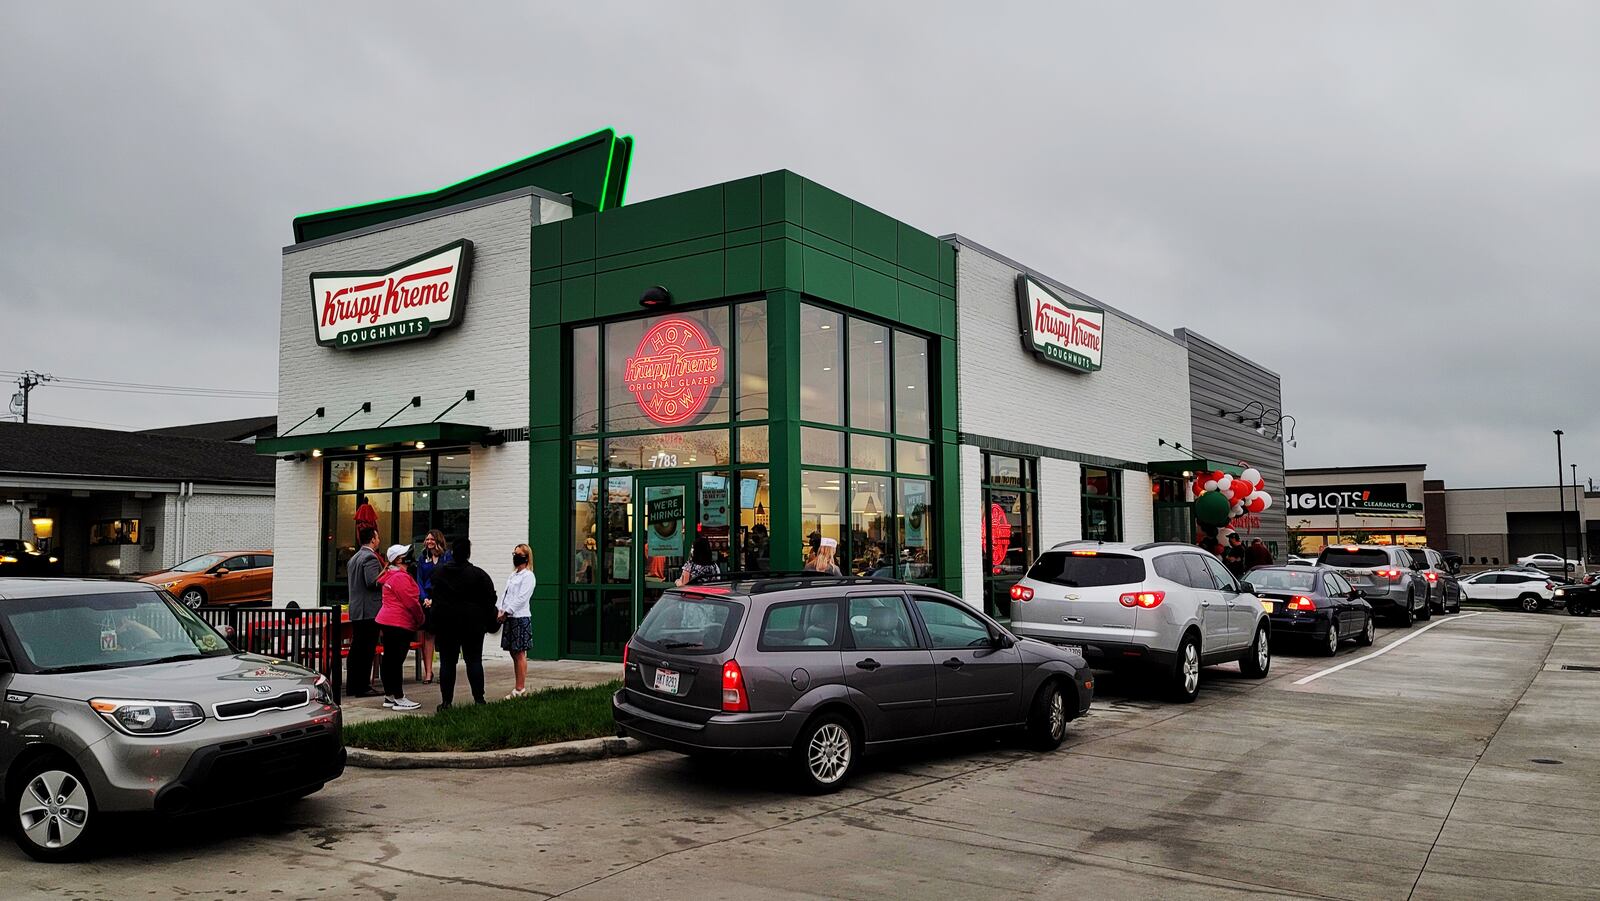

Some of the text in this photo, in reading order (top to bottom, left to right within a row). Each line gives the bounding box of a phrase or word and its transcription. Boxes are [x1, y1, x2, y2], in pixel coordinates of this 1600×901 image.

[321, 265, 454, 328] Krispy Kreme
[342, 320, 424, 345] DOUGHNUTS
[1034, 298, 1101, 352] Krispy Kreme
[650, 326, 693, 352] HOT
[624, 347, 721, 382] Krispy Kreme
[1047, 345, 1091, 368] DOUGHNUTS
[628, 375, 717, 392] ORIGINAL GLAZED
[649, 387, 695, 417] NOW
[651, 454, 678, 468] 7783
[650, 508, 682, 521] HIRING!
[653, 499, 679, 510] WE'RE
[1363, 501, 1400, 509] CLEARANCE
